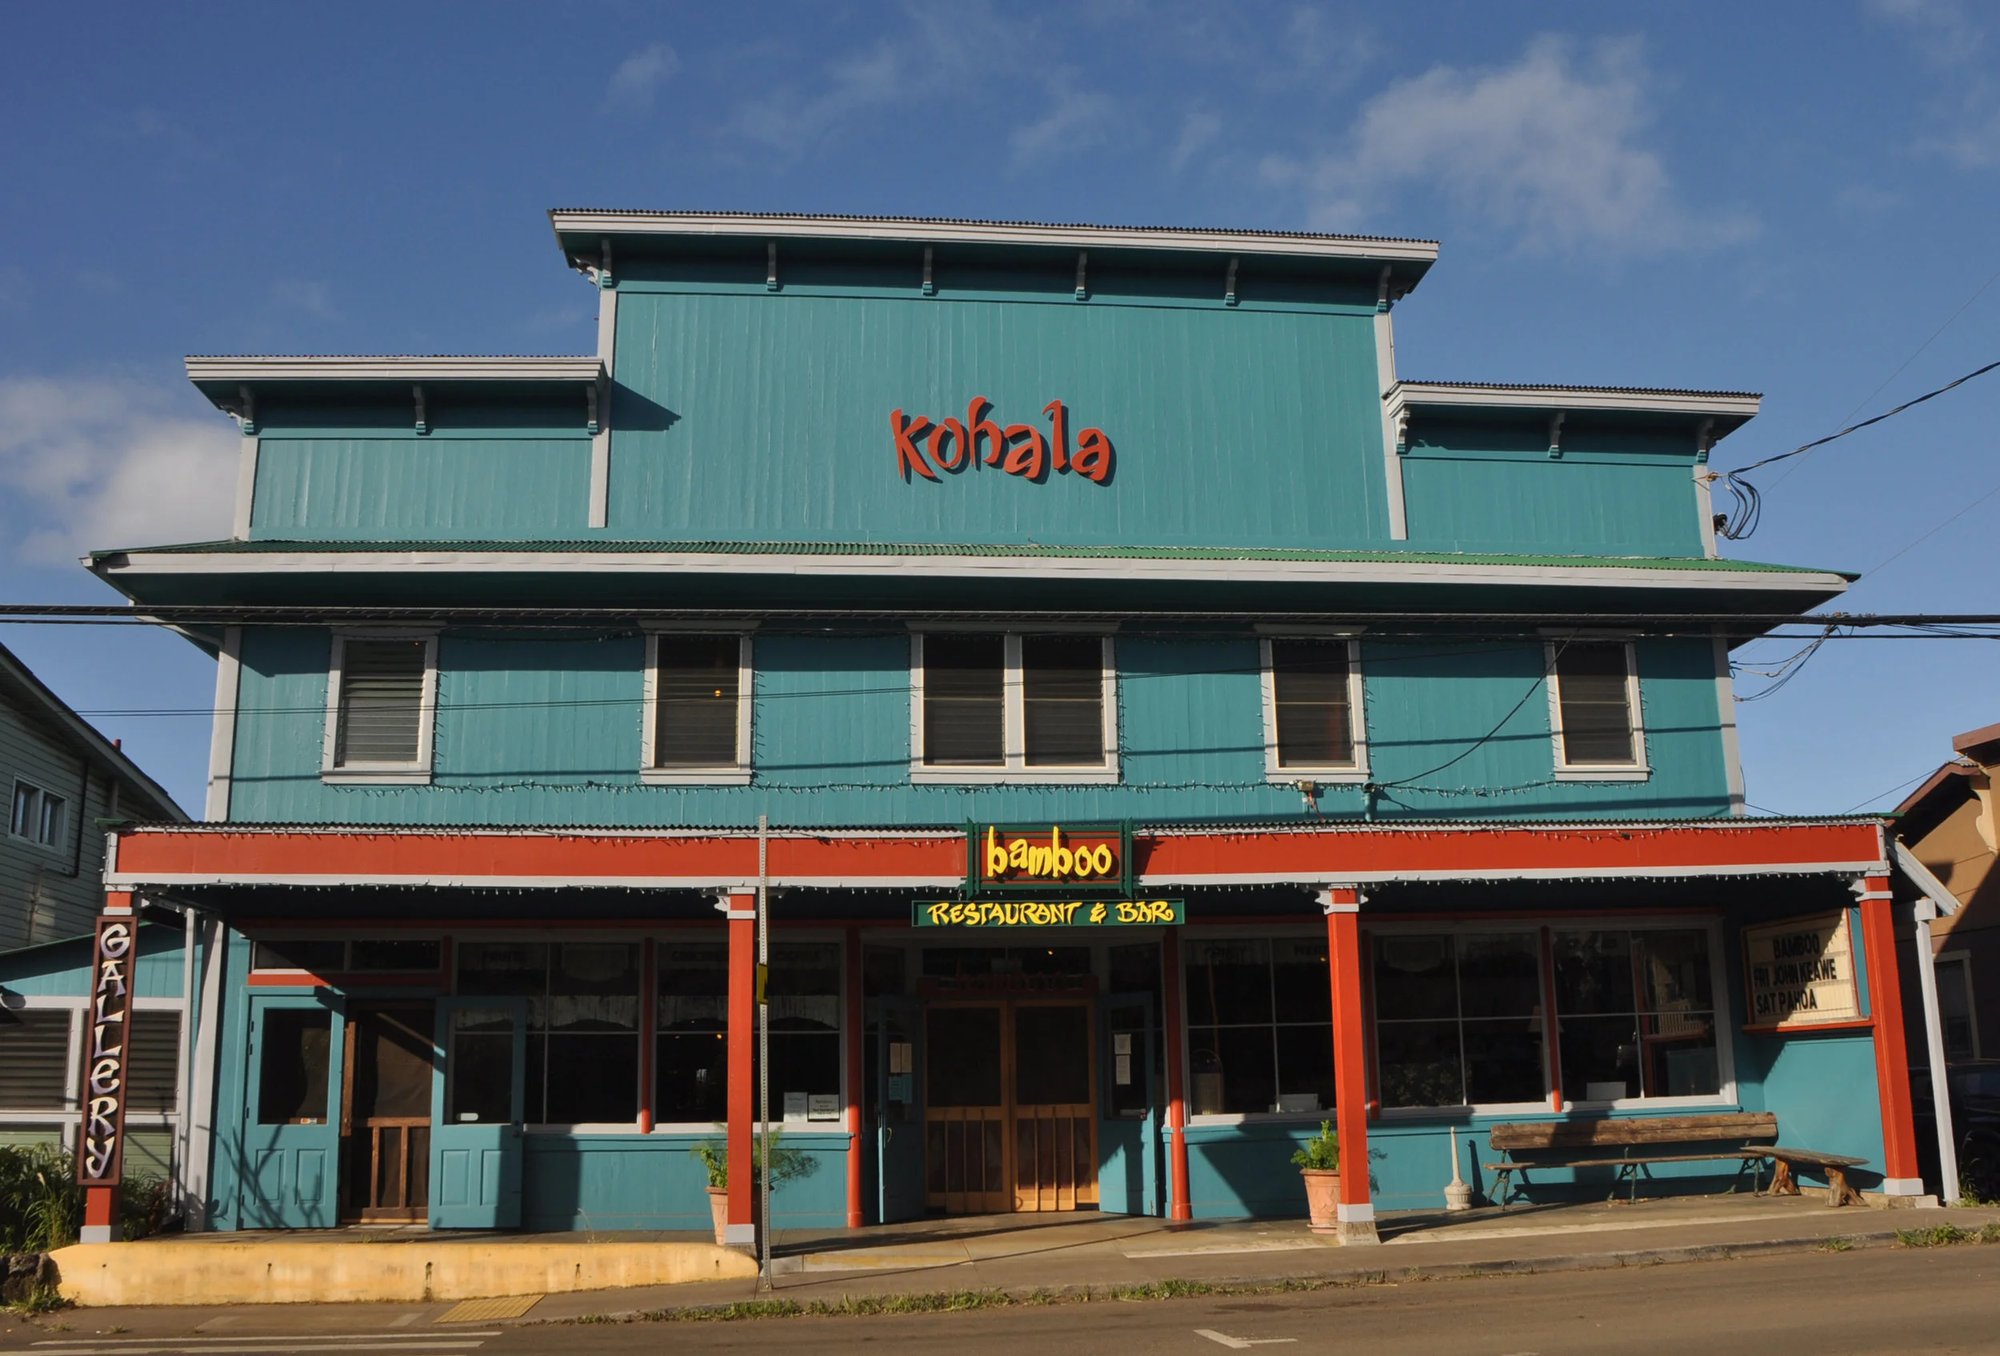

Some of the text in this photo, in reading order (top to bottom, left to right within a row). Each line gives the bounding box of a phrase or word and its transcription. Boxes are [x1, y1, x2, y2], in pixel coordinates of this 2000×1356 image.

[987, 825, 1112, 877] bamboo
[927, 901, 1175, 925] RESTAURANT & BAR
[1773, 933, 1820, 958] BAMBOO
[1754, 958, 1837, 988] FRI JOHN KEAWE
[1756, 992, 1777, 1014] SAT
